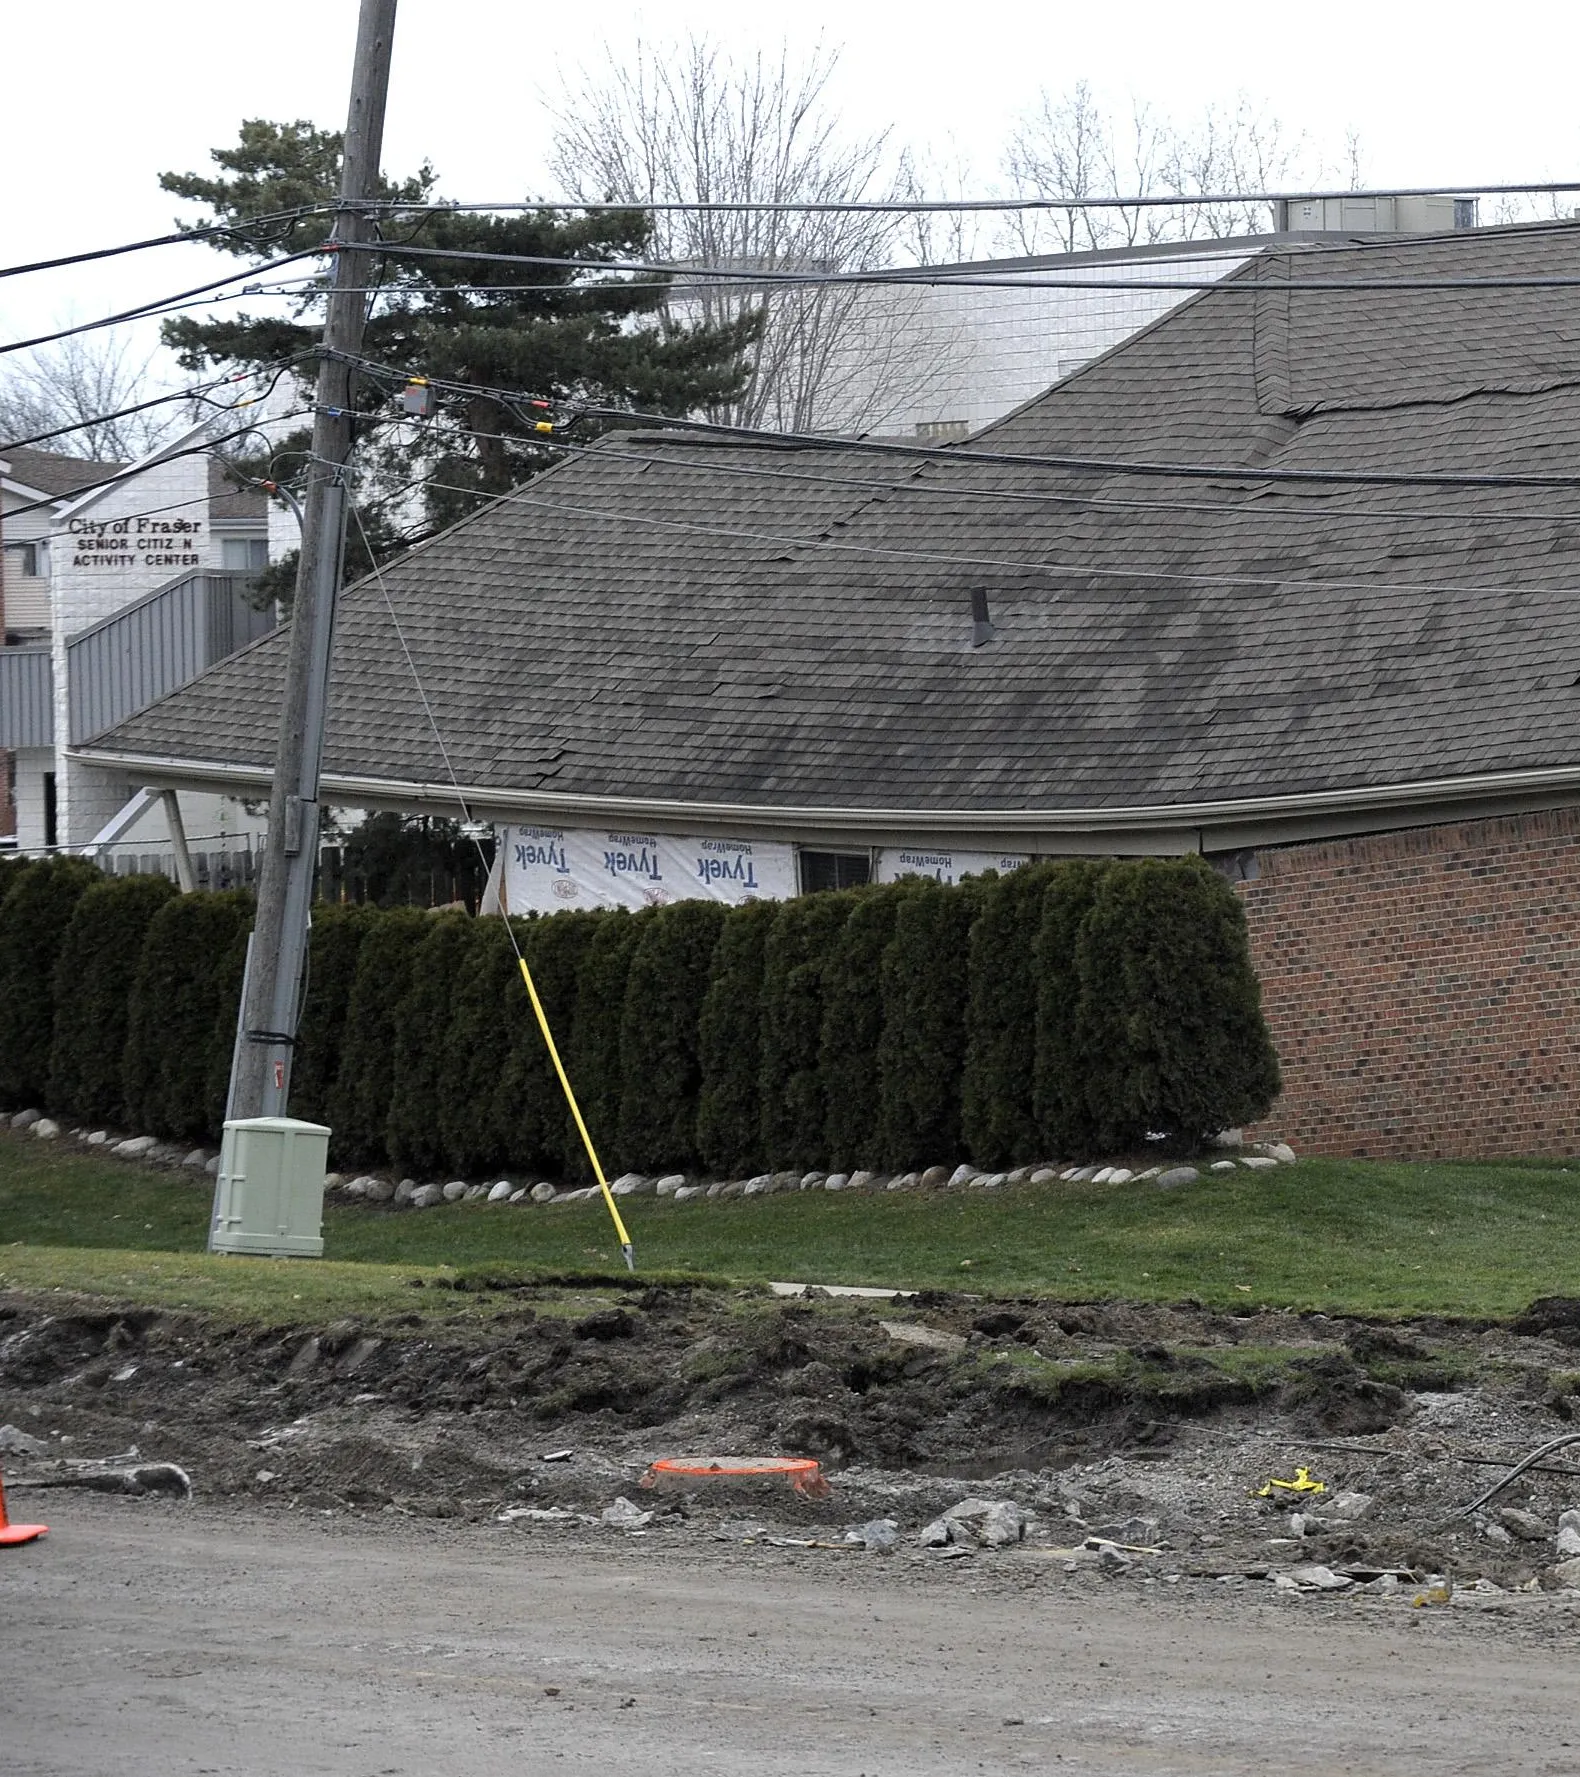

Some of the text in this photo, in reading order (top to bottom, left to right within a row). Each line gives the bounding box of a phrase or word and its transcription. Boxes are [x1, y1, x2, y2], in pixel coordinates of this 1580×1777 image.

[69, 518, 202, 538] City of Fraser
[77, 539, 128, 550] SENIOR
[73, 554, 199, 566] ACTIVITY CENTER
[519, 825, 564, 842] HomeWrap
[608, 833, 657, 849] HomeWrap
[701, 840, 752, 856] HomeWrap
[514, 841, 570, 873] Tyvek
[603, 847, 662, 880] Tyvek
[900, 854, 952, 869] HomeWrap
[697, 854, 758, 888] Tyvek
